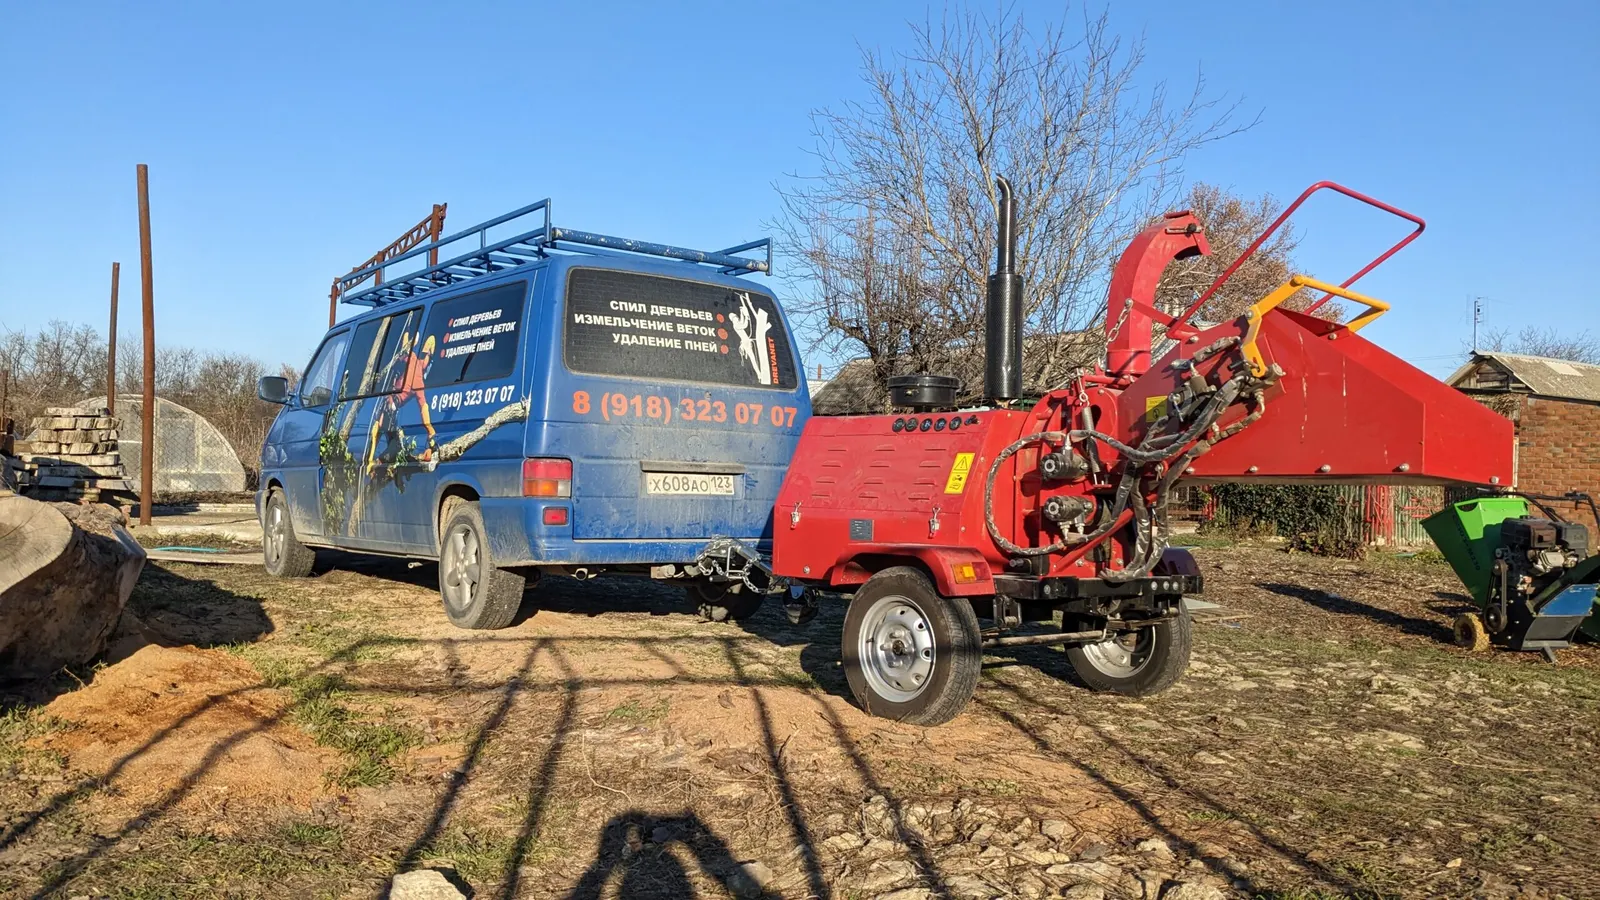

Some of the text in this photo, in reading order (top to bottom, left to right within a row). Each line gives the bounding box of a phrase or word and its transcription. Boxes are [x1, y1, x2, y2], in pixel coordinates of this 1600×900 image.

[452, 309, 502, 328] СПИЛ ДЕРЕВЬЕВ
[610, 300, 714, 322] СПИЛ ДЕРЕВЬЕВ
[448, 321, 517, 343] ИЗМЕЛЬЧЕНИЕ ВЕТОК
[574, 313, 716, 338] ИЗМЕЛЬЧЕНИЕ ВЕТОК
[445, 338, 495, 358] УДАЛЕНИЕ ПНЕЙ
[612, 333, 718, 353] УДАЛЕНИЕ ПНЕЙ
[767, 336, 779, 384] DREVANET
[431, 385, 515, 412] 8 (918) 323 07 07
[572, 390, 797, 428] 8 (918) 323 07 07
[711, 476, 731, 489] 123
